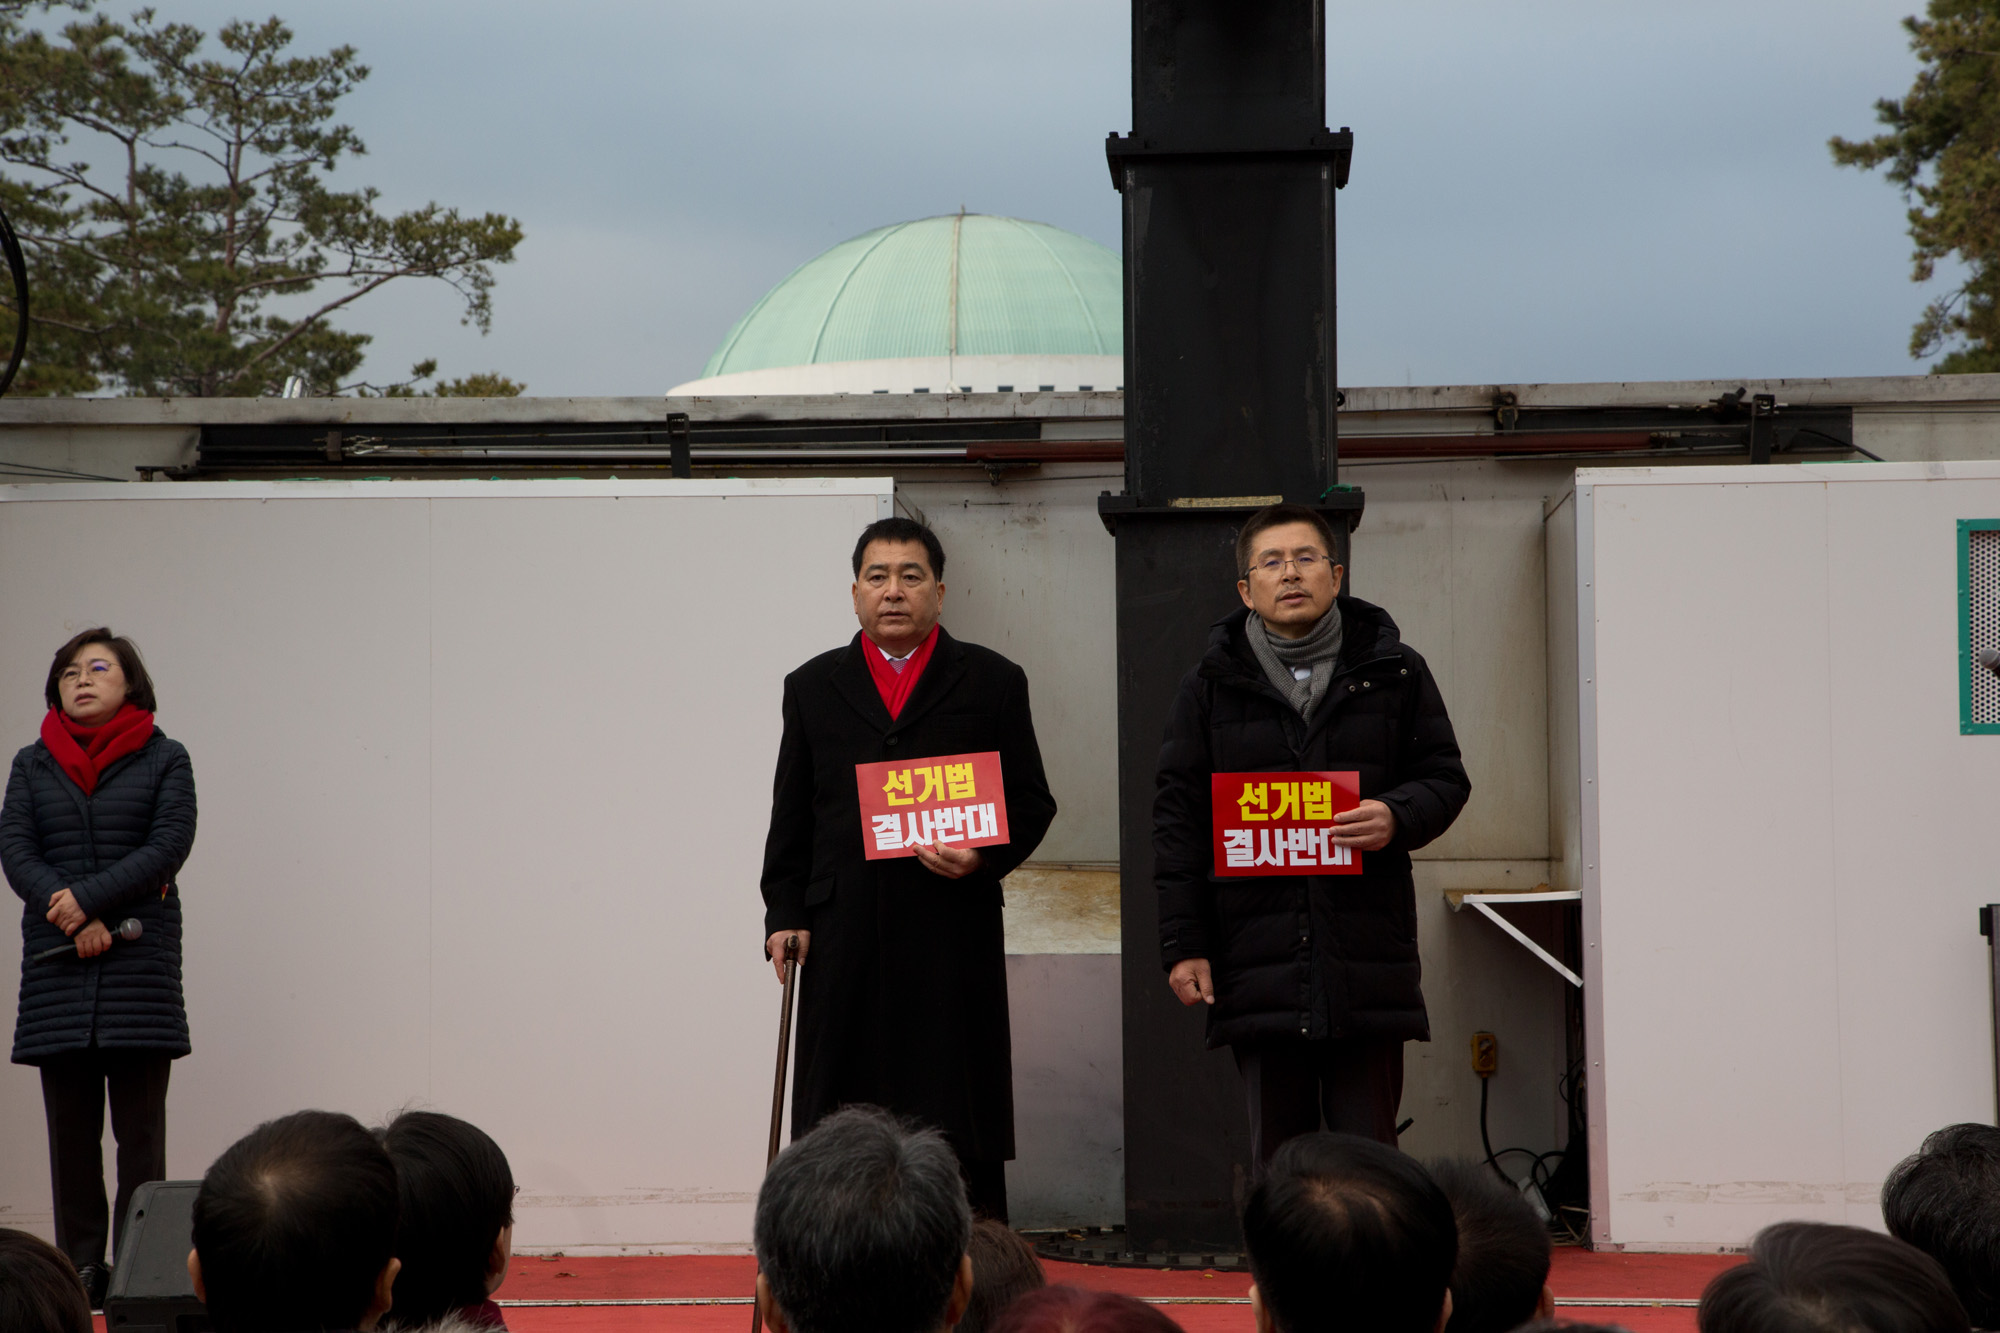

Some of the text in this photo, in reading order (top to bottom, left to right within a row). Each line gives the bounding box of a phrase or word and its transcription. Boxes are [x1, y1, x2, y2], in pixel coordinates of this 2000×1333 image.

[882, 763, 976, 806] 선거법
[1236, 781, 1332, 821] 선거법
[872, 803, 998, 851] 결사반대
